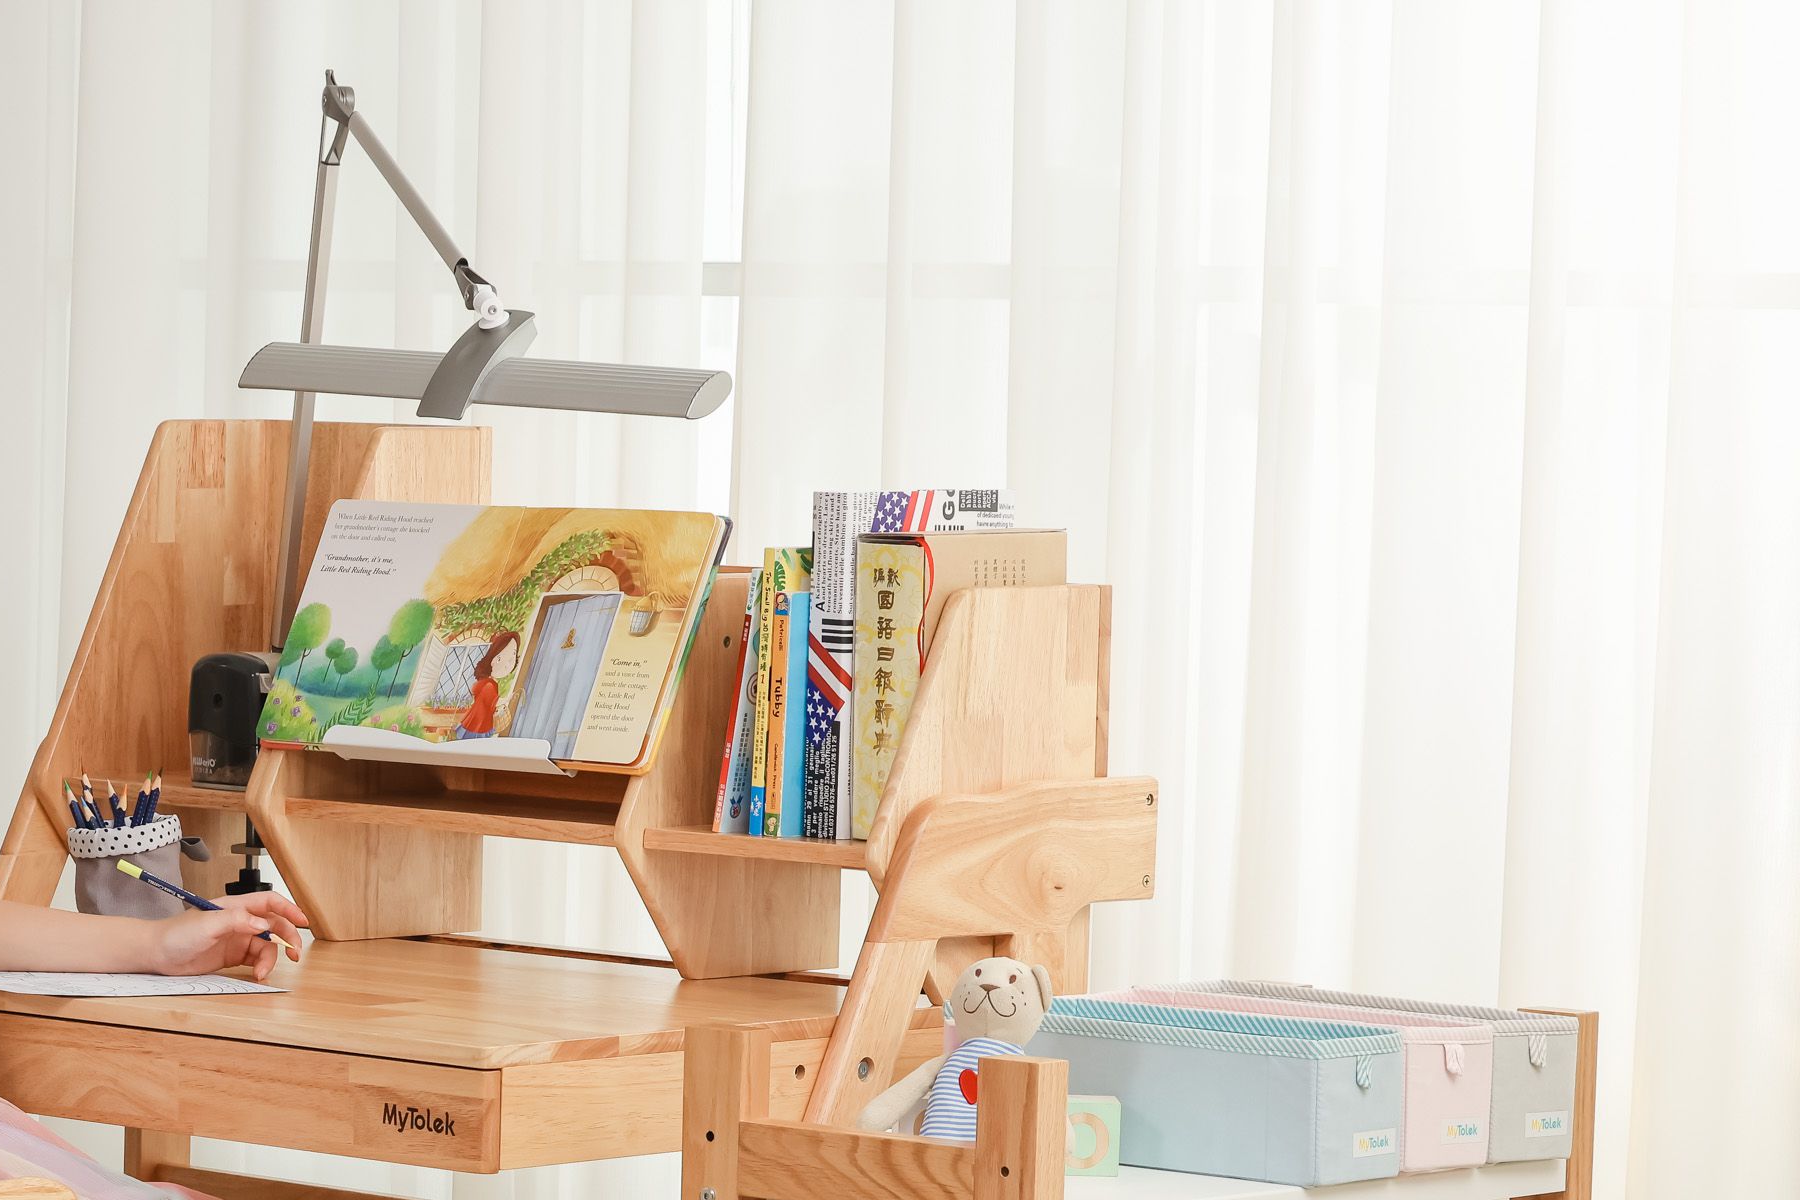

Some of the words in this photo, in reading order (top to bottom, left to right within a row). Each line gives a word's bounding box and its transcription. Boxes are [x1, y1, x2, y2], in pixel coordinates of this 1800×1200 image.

[380, 515, 397, 523] Riding
[351, 567, 372, 576] Riding
[815, 601, 826, 611] A
[772, 677, 782, 718] Tubby
[382, 1102, 455, 1136] MyTolek
[1531, 1117, 1562, 1132] MyTolek
[1447, 1124, 1478, 1139] MyTolek
[1359, 1136, 1389, 1151] MyTolek
